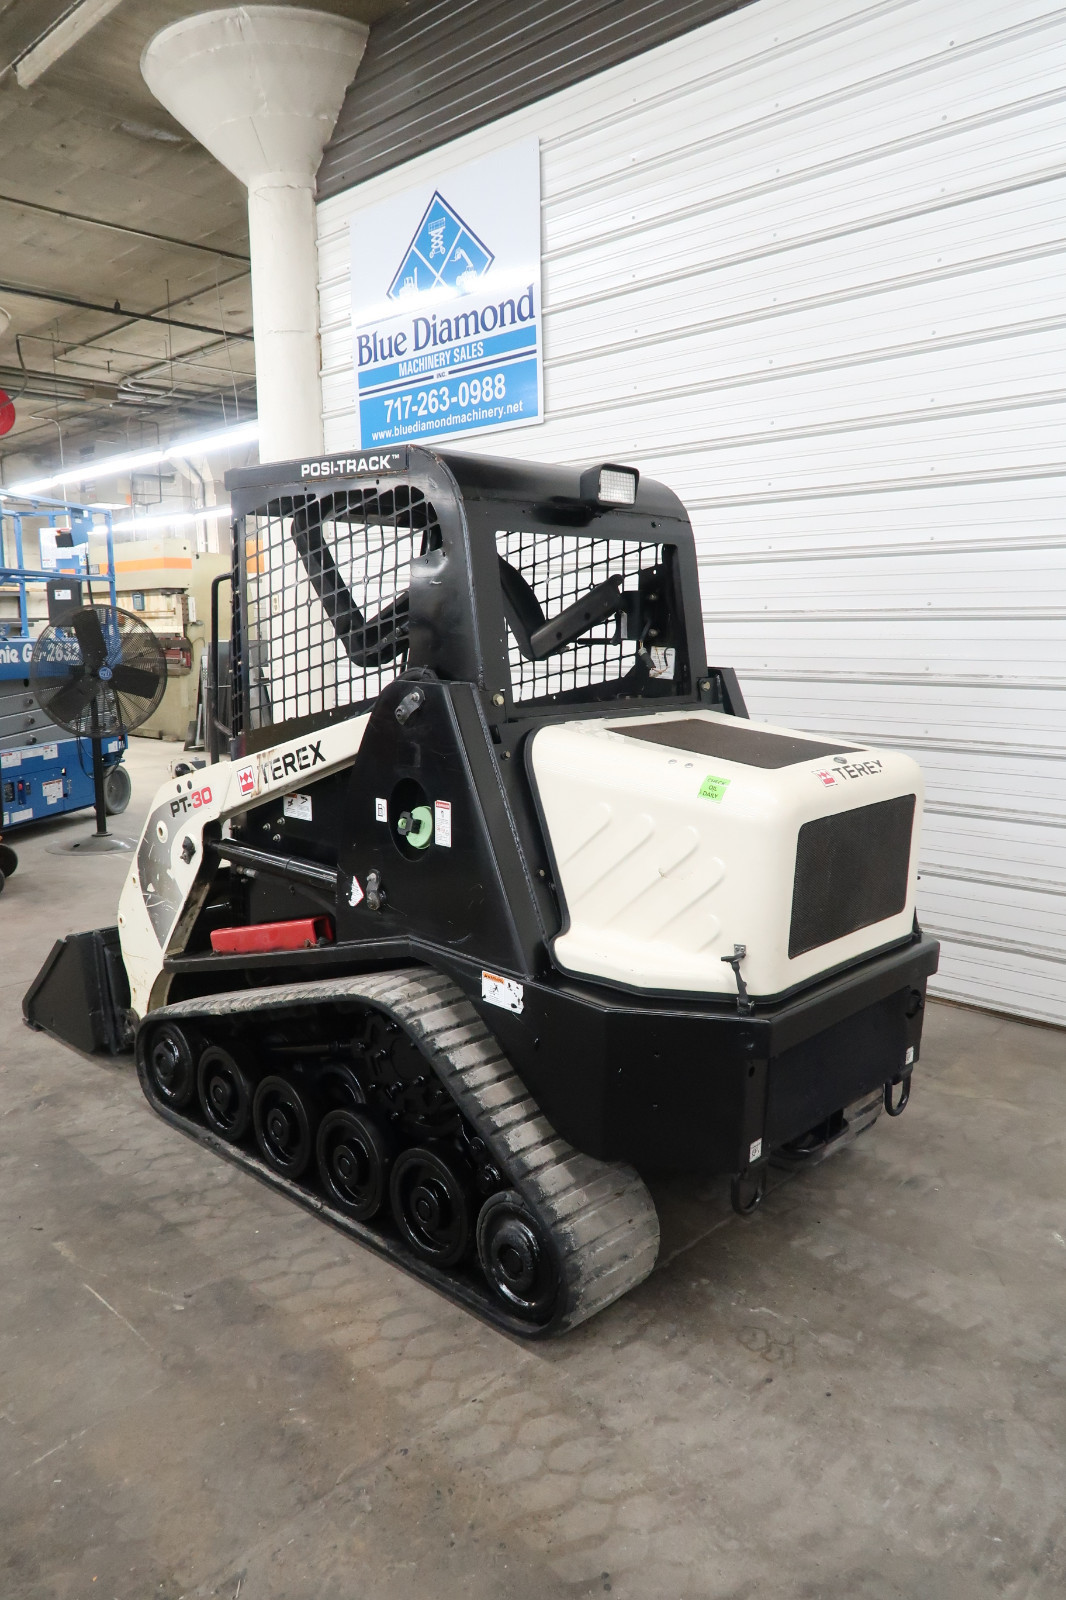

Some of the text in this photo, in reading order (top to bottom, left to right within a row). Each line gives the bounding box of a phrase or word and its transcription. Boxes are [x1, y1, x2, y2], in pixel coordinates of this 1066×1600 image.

[356, 282, 536, 367] Blue Diamond
[398, 341, 484, 377] MACHINERY SALES
[383, 373, 506, 424] 717-263-0988
[371, 400, 524, 441] www.bluediamondmachinery.net
[260, 740, 327, 785] TEREX
[169, 786, 213, 818] PT-30
